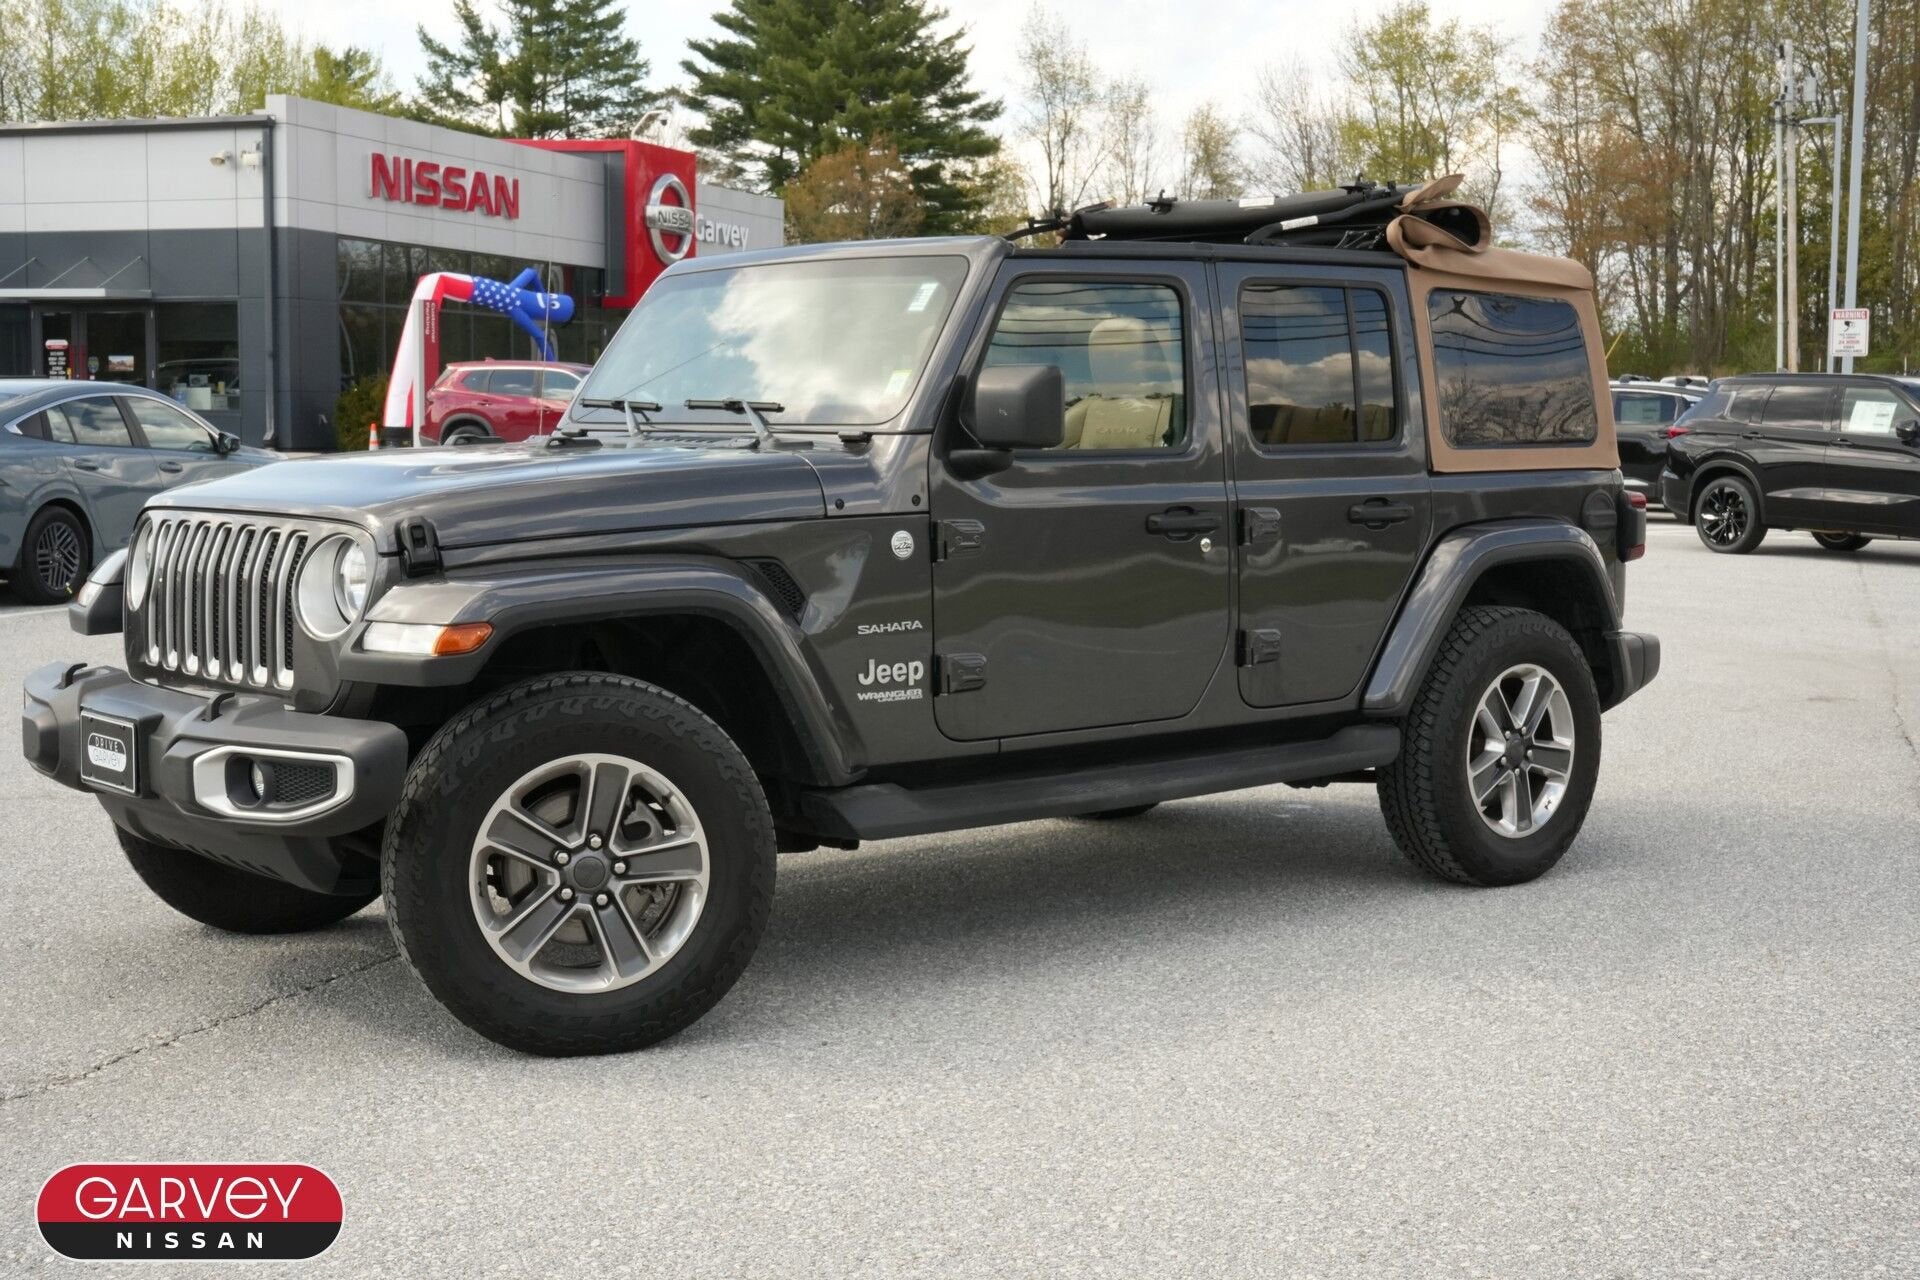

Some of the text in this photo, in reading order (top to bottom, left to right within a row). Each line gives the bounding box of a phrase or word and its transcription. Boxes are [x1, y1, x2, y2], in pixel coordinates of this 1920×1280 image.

[372, 153, 519, 219] NISSAN
[696, 213, 749, 252] Garvey
[1835, 311, 1866, 319] WARNING
[858, 620, 923, 635] SAHARA
[858, 659, 924, 686] Jeep
[857, 688, 922, 701] WRANGLER
[95, 736, 118, 752] DRIVE
